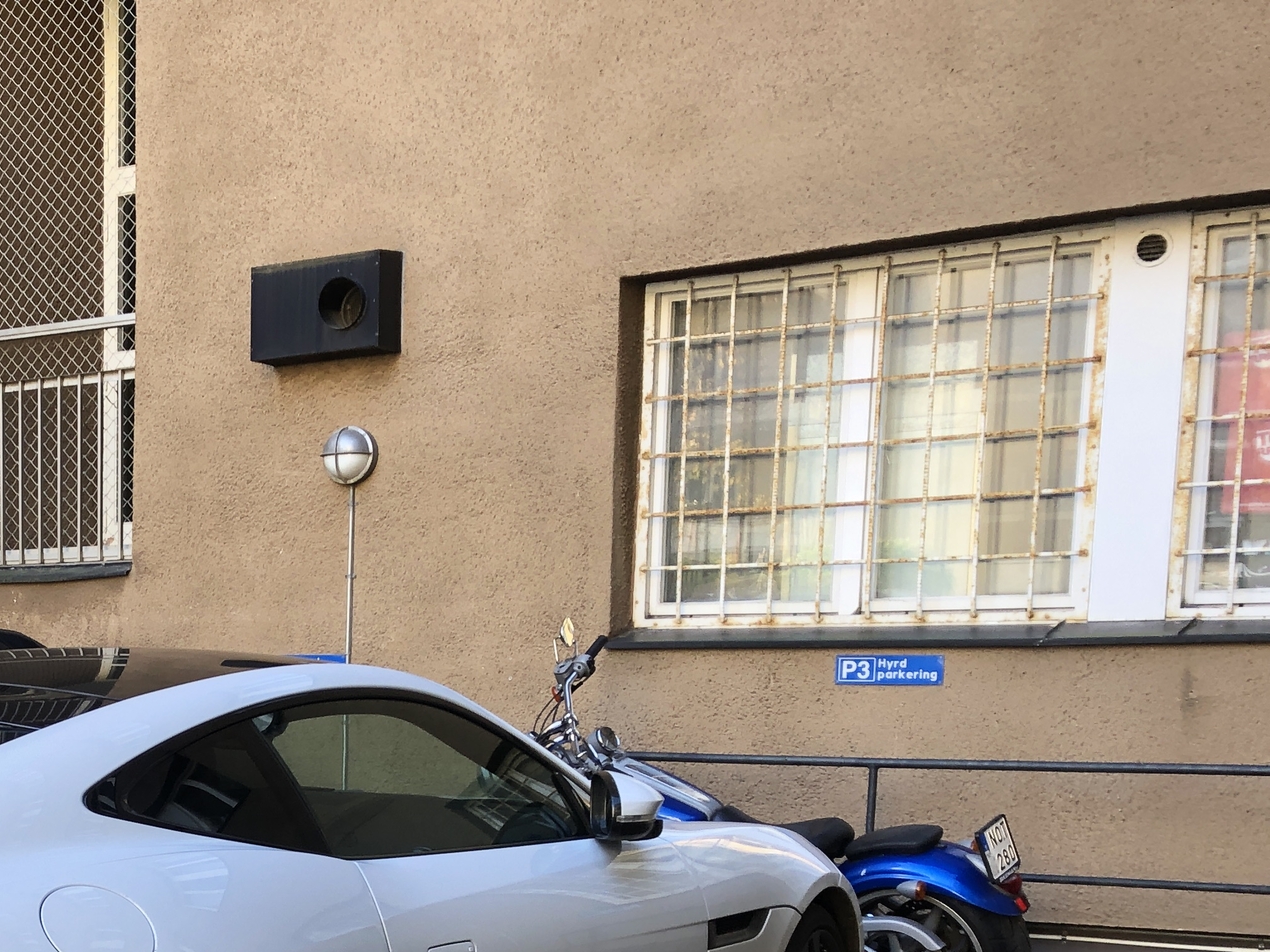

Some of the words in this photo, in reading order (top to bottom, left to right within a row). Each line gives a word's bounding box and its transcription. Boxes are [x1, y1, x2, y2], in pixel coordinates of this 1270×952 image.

[842, 660, 871, 679] P3
[877, 658, 907, 670] Hyrd
[877, 669, 938, 681] parkering
